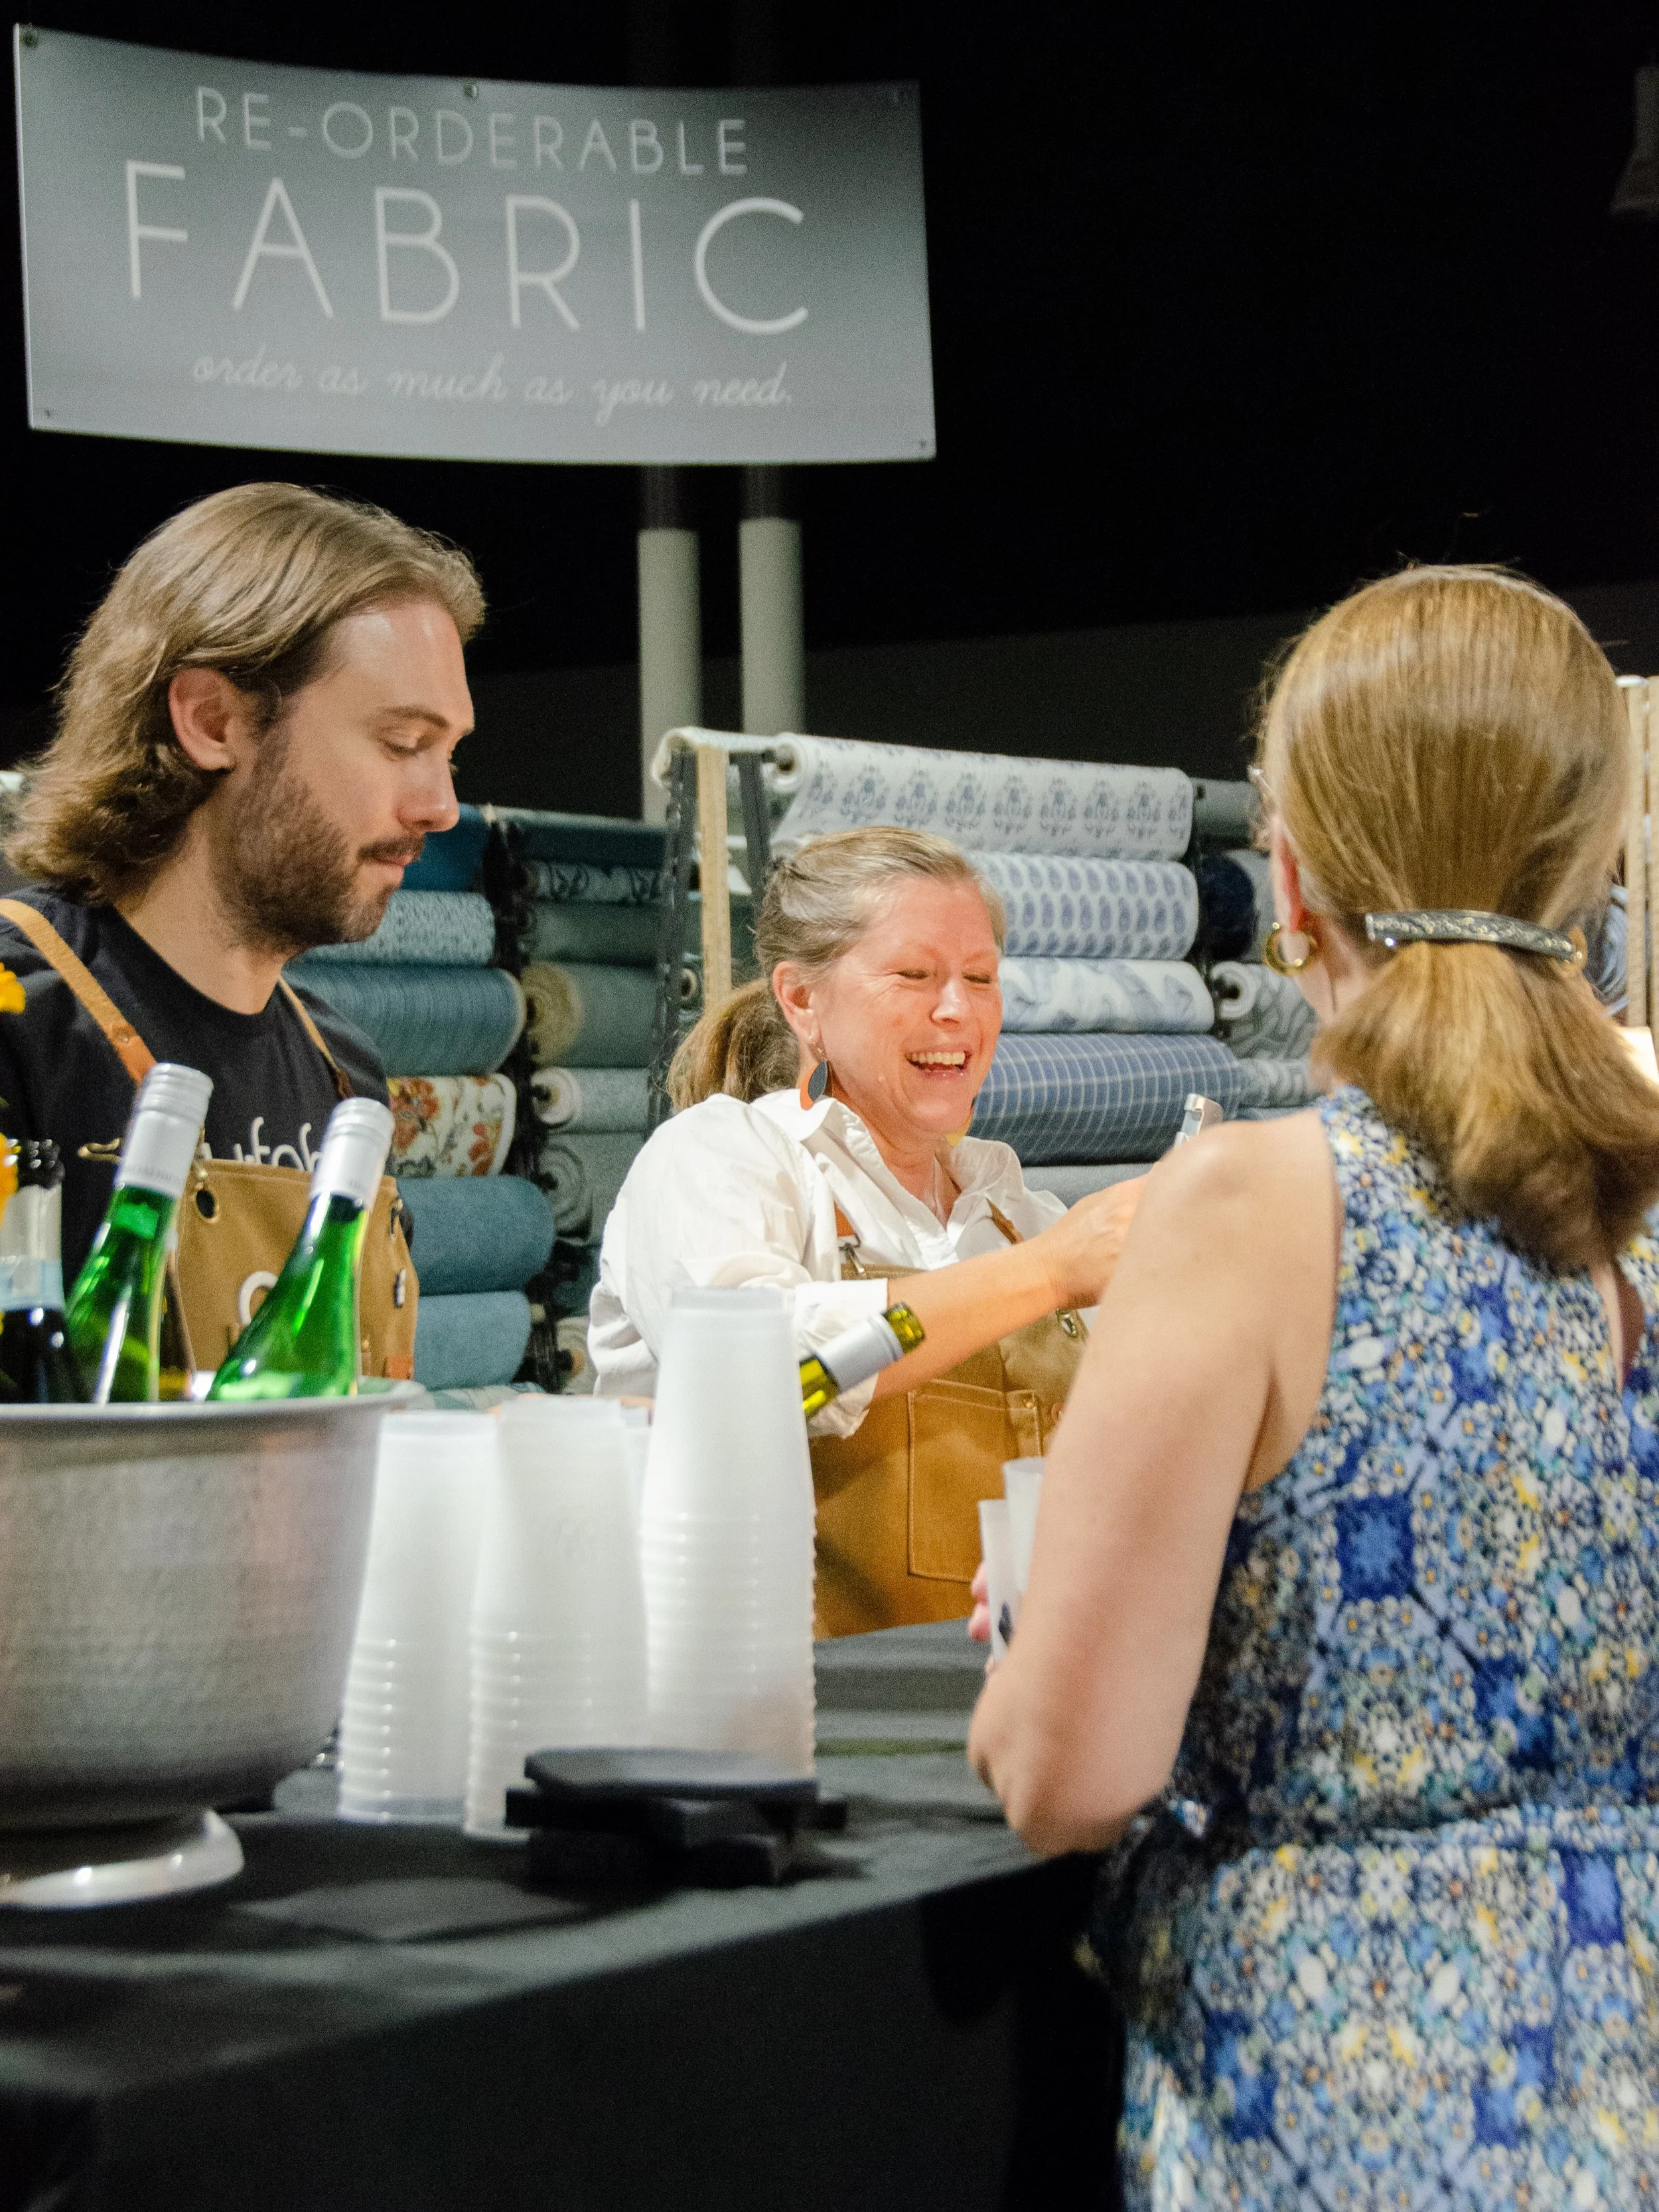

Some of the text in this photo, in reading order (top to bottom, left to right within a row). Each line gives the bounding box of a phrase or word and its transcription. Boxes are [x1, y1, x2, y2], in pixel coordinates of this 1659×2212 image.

[194, 86, 749, 177] RE-ORDERABLE
[126, 159, 810, 334] FABRIC
[193, 344, 303, 390] order
[318, 364, 370, 396] as
[387, 352, 508, 400] much
[526, 376, 575, 404] as
[594, 378, 676, 426] you
